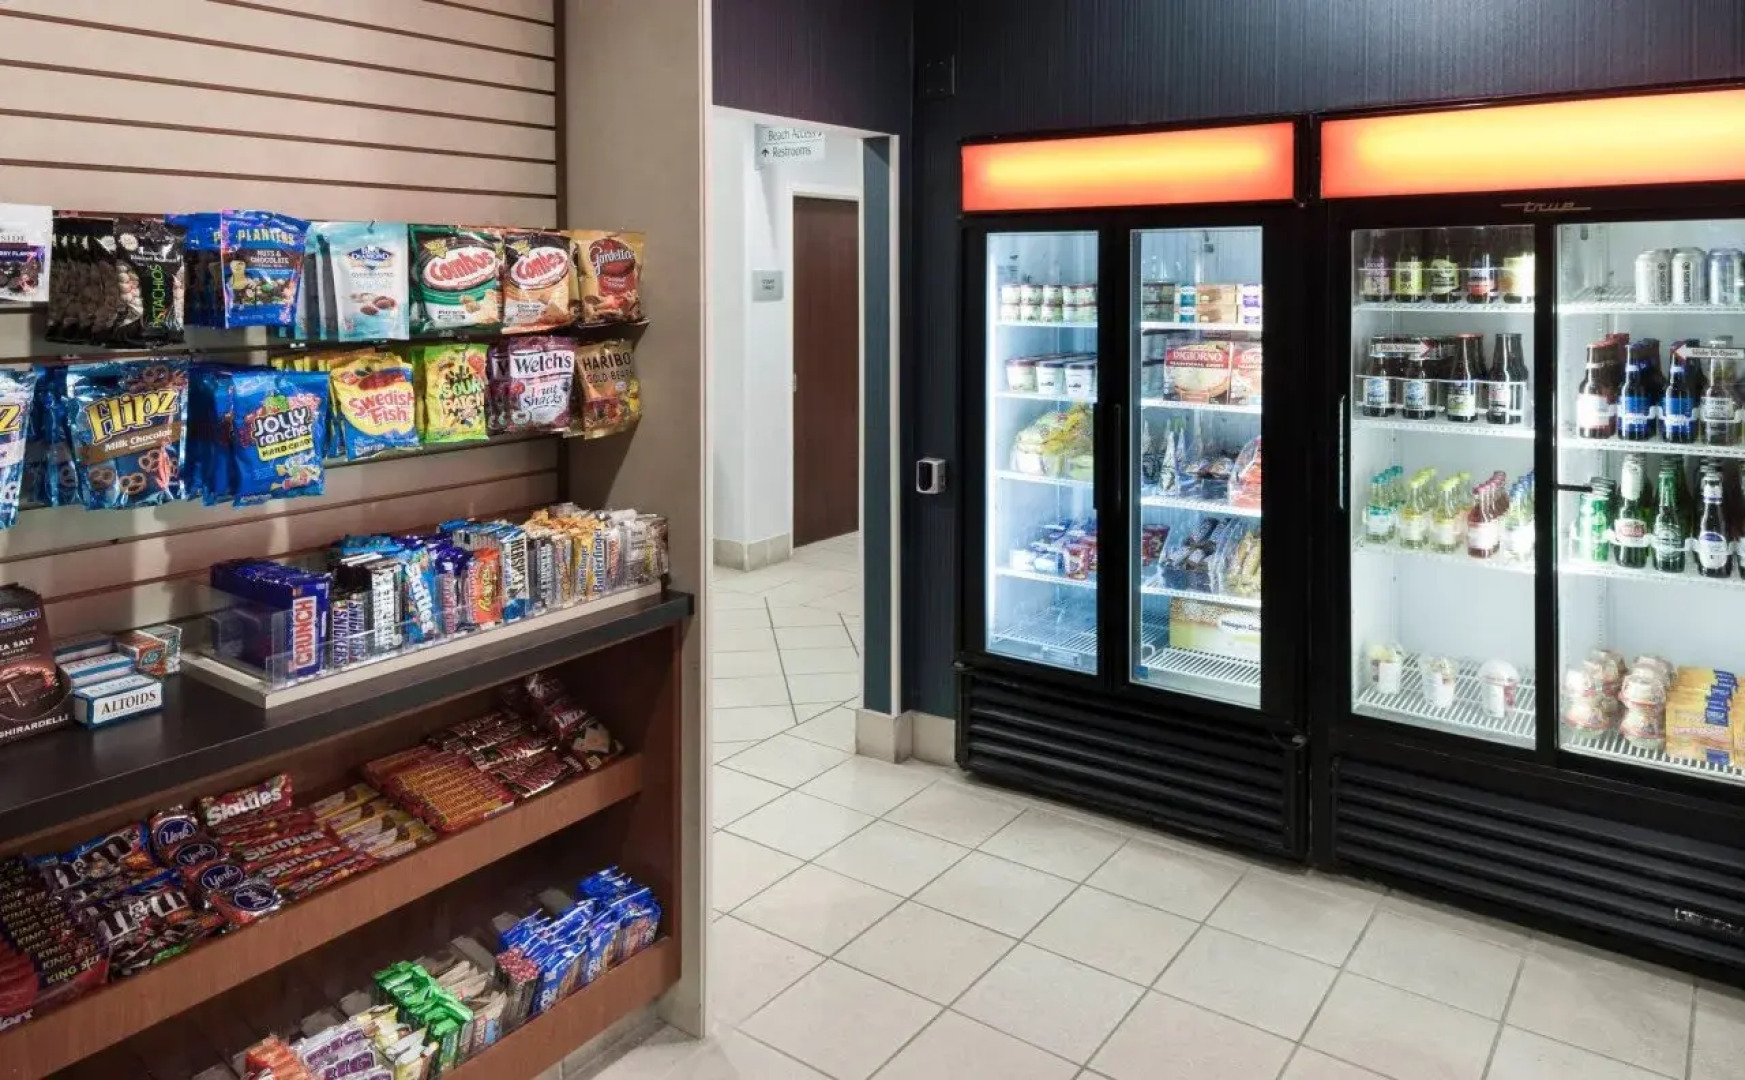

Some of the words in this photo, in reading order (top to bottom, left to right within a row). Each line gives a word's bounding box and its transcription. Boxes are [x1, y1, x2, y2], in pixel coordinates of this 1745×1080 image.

[772, 147, 812, 158] Restrooms
[237, 228, 295, 246] PLANTERS
[429, 252, 494, 281] Combos
[516, 251, 565, 280] Combos
[514, 353, 572, 374] Welch's
[582, 351, 632, 372] HARIBO
[586, 373, 609, 384] GOLD
[523, 393, 562, 408] Snacks
[86, 389, 178, 443] Flipz
[254, 407, 308, 437] JOLLY
[369, 405, 407, 425] Fish
[104, 441, 129, 452] Milk
[13, 637, 35, 649] SALT
[294, 599, 313, 667] CRUNCH
[333, 610, 348, 665] SNICKERS
[101, 690, 157, 715] ALTOIDS
[206, 787, 282, 827] Skittles
[162, 822, 190, 844] York
[207, 863, 236, 889] York
[47, 964, 78, 984] KING
